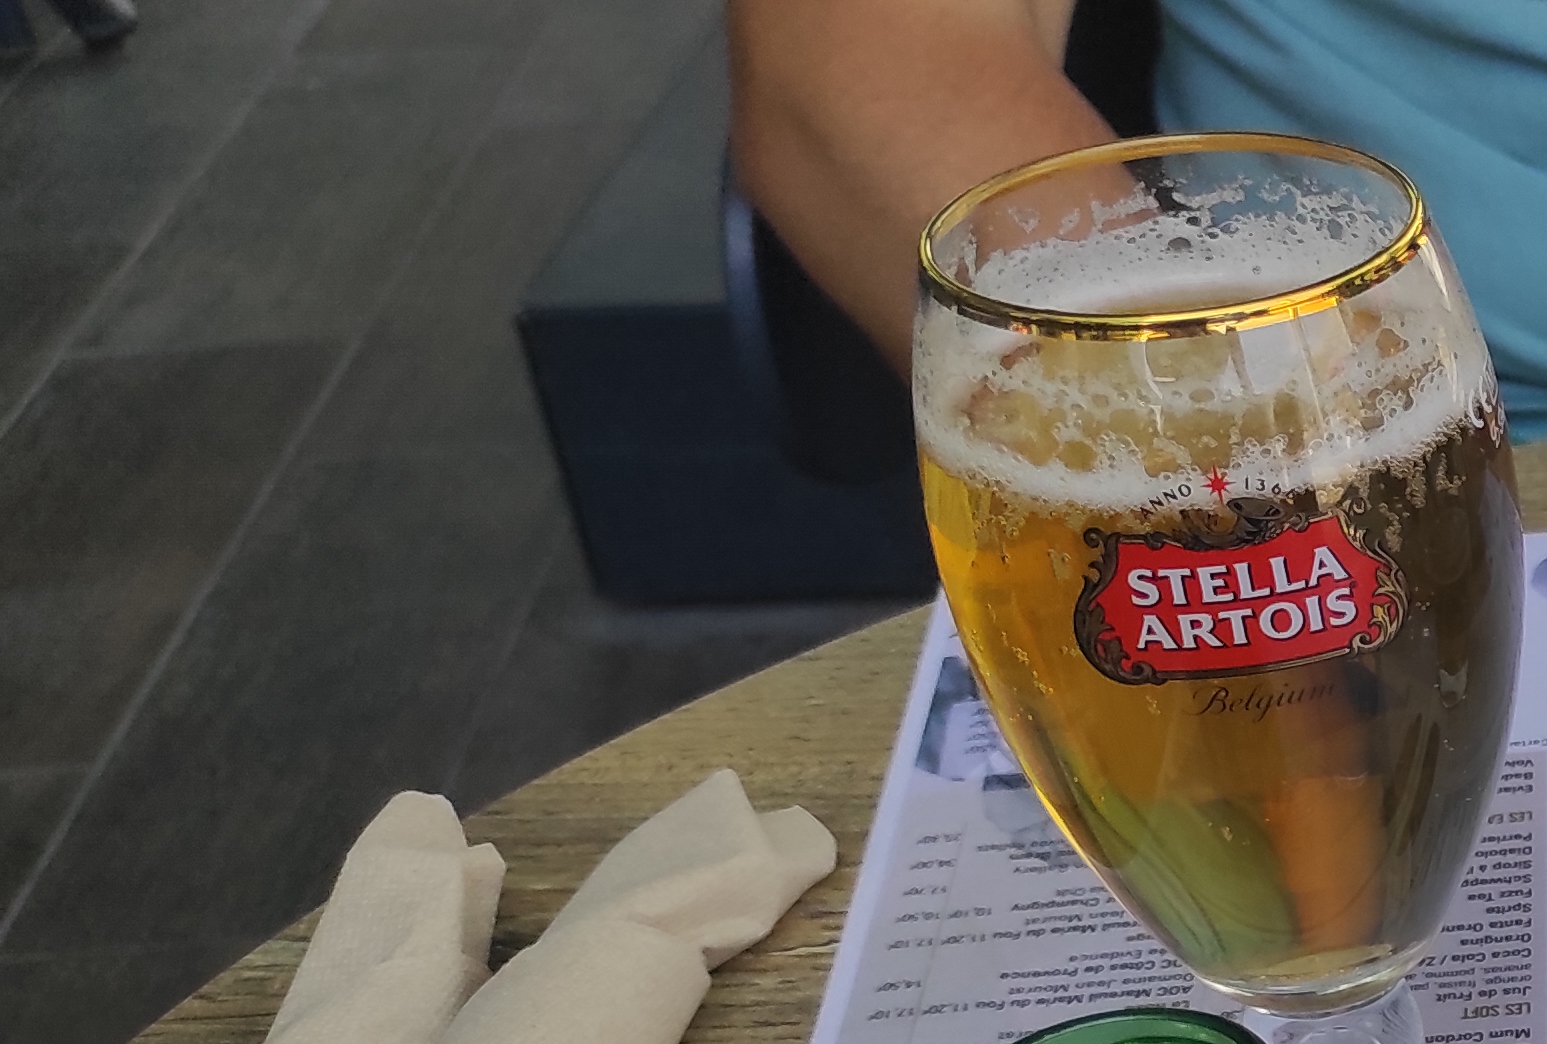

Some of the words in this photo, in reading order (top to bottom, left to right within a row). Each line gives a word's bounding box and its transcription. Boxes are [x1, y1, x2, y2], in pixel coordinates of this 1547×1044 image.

[1141, 483, 1192, 520] ANNO
[1127, 545, 1350, 607] STELLA
[1137, 587, 1357, 650] ARTOIS
[1189, 682, 1335, 722] Belgium
[1460, 1004, 1500, 1020] SOFT
[1504, 1001, 1531, 1016] LES
